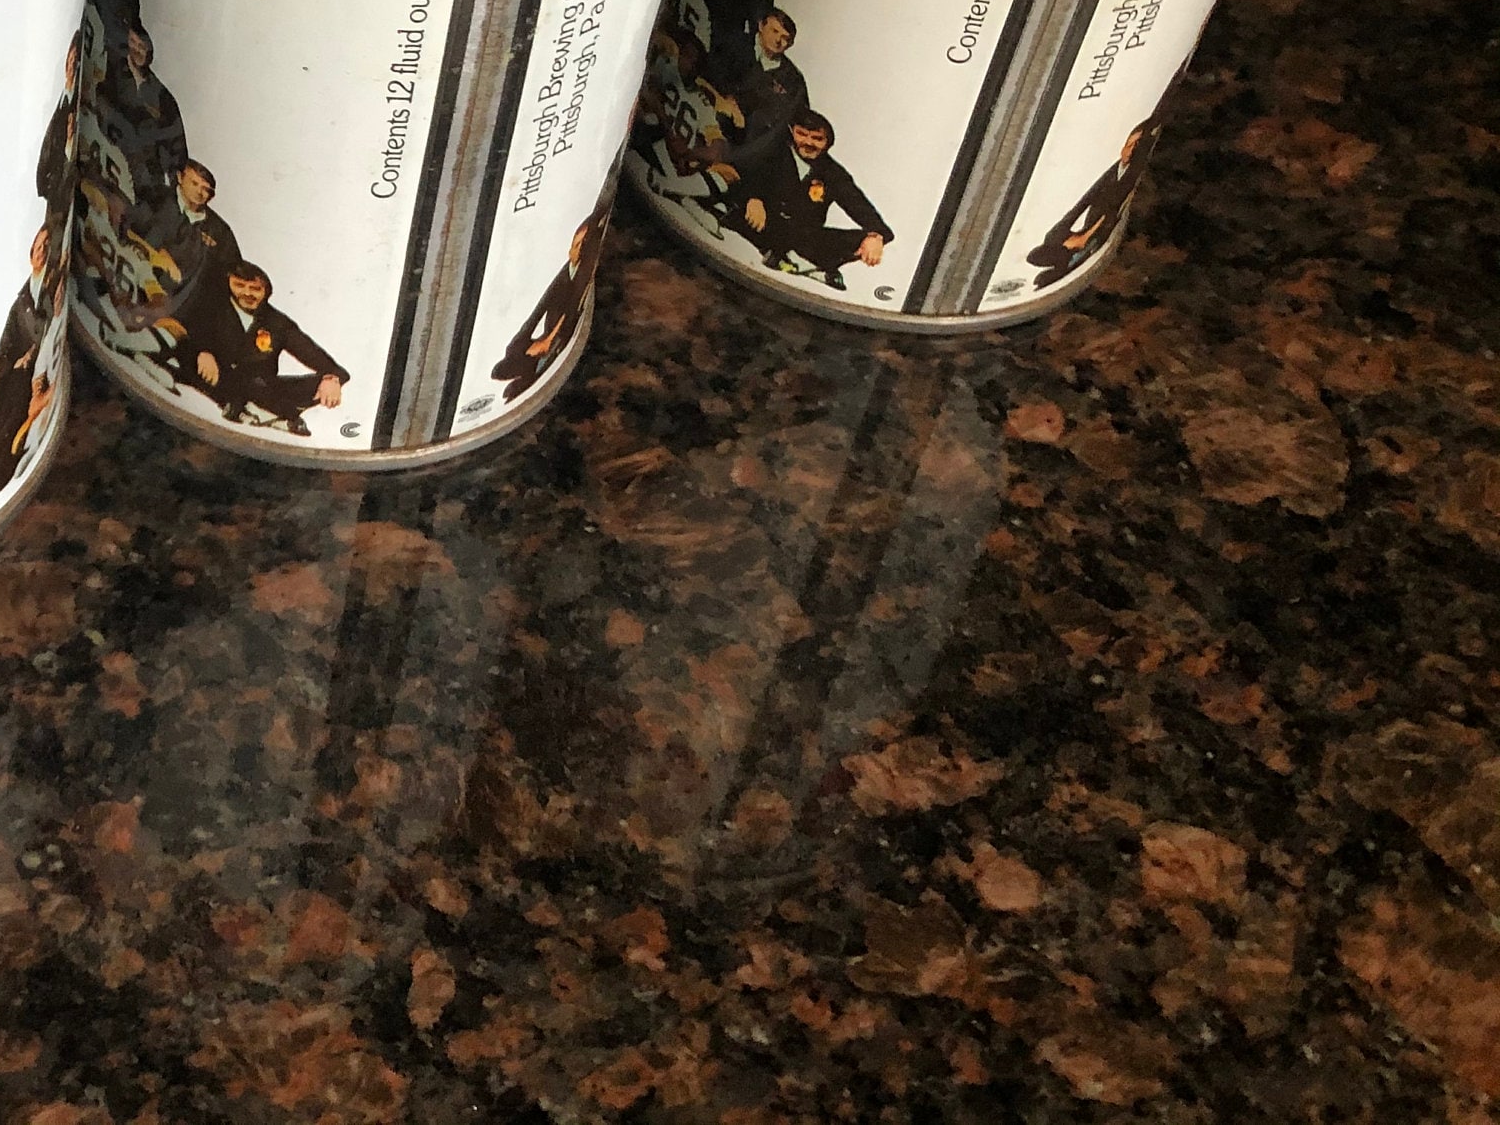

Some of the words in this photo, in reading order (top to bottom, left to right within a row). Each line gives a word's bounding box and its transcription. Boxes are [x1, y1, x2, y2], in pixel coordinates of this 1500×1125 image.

[386, 79, 416, 104] 12
[390, 29, 425, 75] fluid
[553, 33, 601, 157] Pittsburgh,
[370, 107, 411, 199] Contents
[514, 98, 560, 213] Pittsburgh
[538, 1, 585, 101] Brewing
